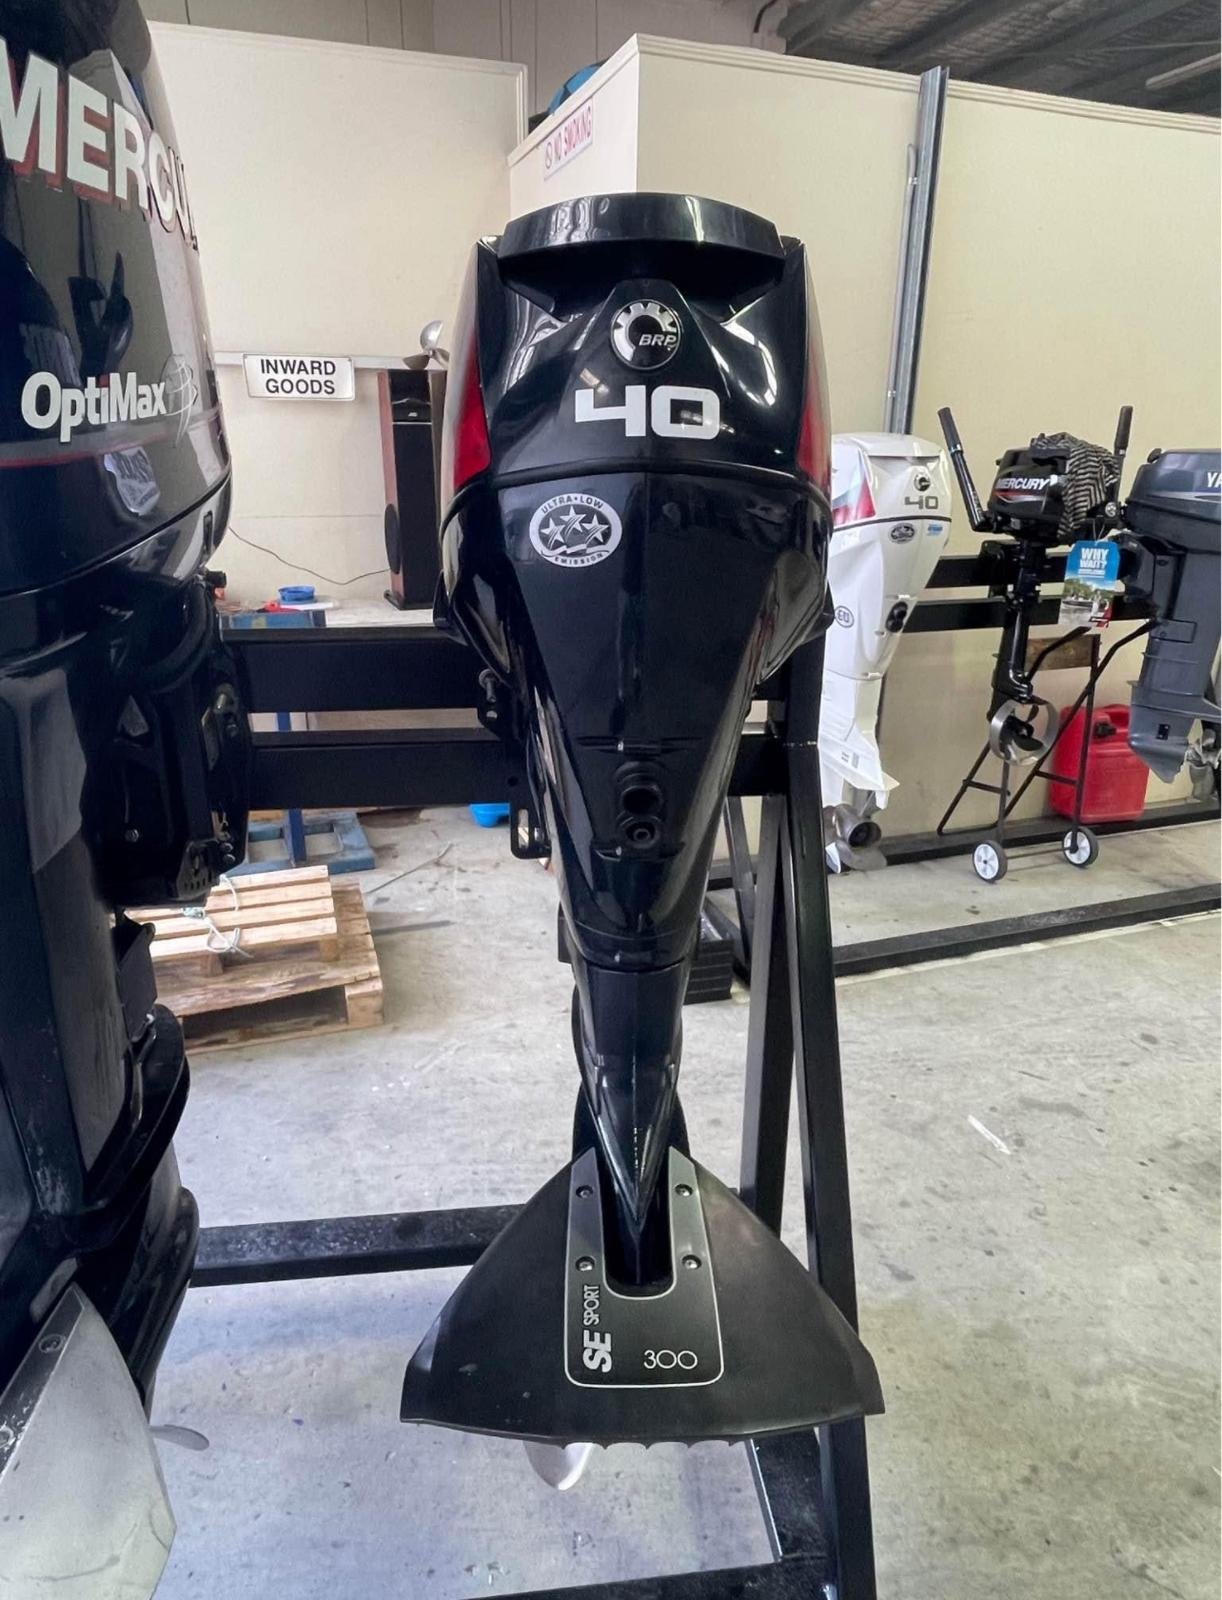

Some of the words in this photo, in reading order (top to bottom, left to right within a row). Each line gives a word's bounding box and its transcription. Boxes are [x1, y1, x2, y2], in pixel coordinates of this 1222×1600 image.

[0, 34, 198, 250] MERCU
[638, 333, 677, 347] BRP
[260, 358, 336, 375] INWARD
[265, 378, 336, 395] GOODS
[21, 371, 167, 443] OptiMax
[575, 385, 720, 440] 40
[994, 477, 1050, 490] MERCURY
[904, 495, 939, 510] 40
[1081, 547, 1109, 560] WHY
[583, 1284, 600, 1326] SPORT
[582, 1329, 613, 1373] SE
[643, 1349, 698, 1370] 300
